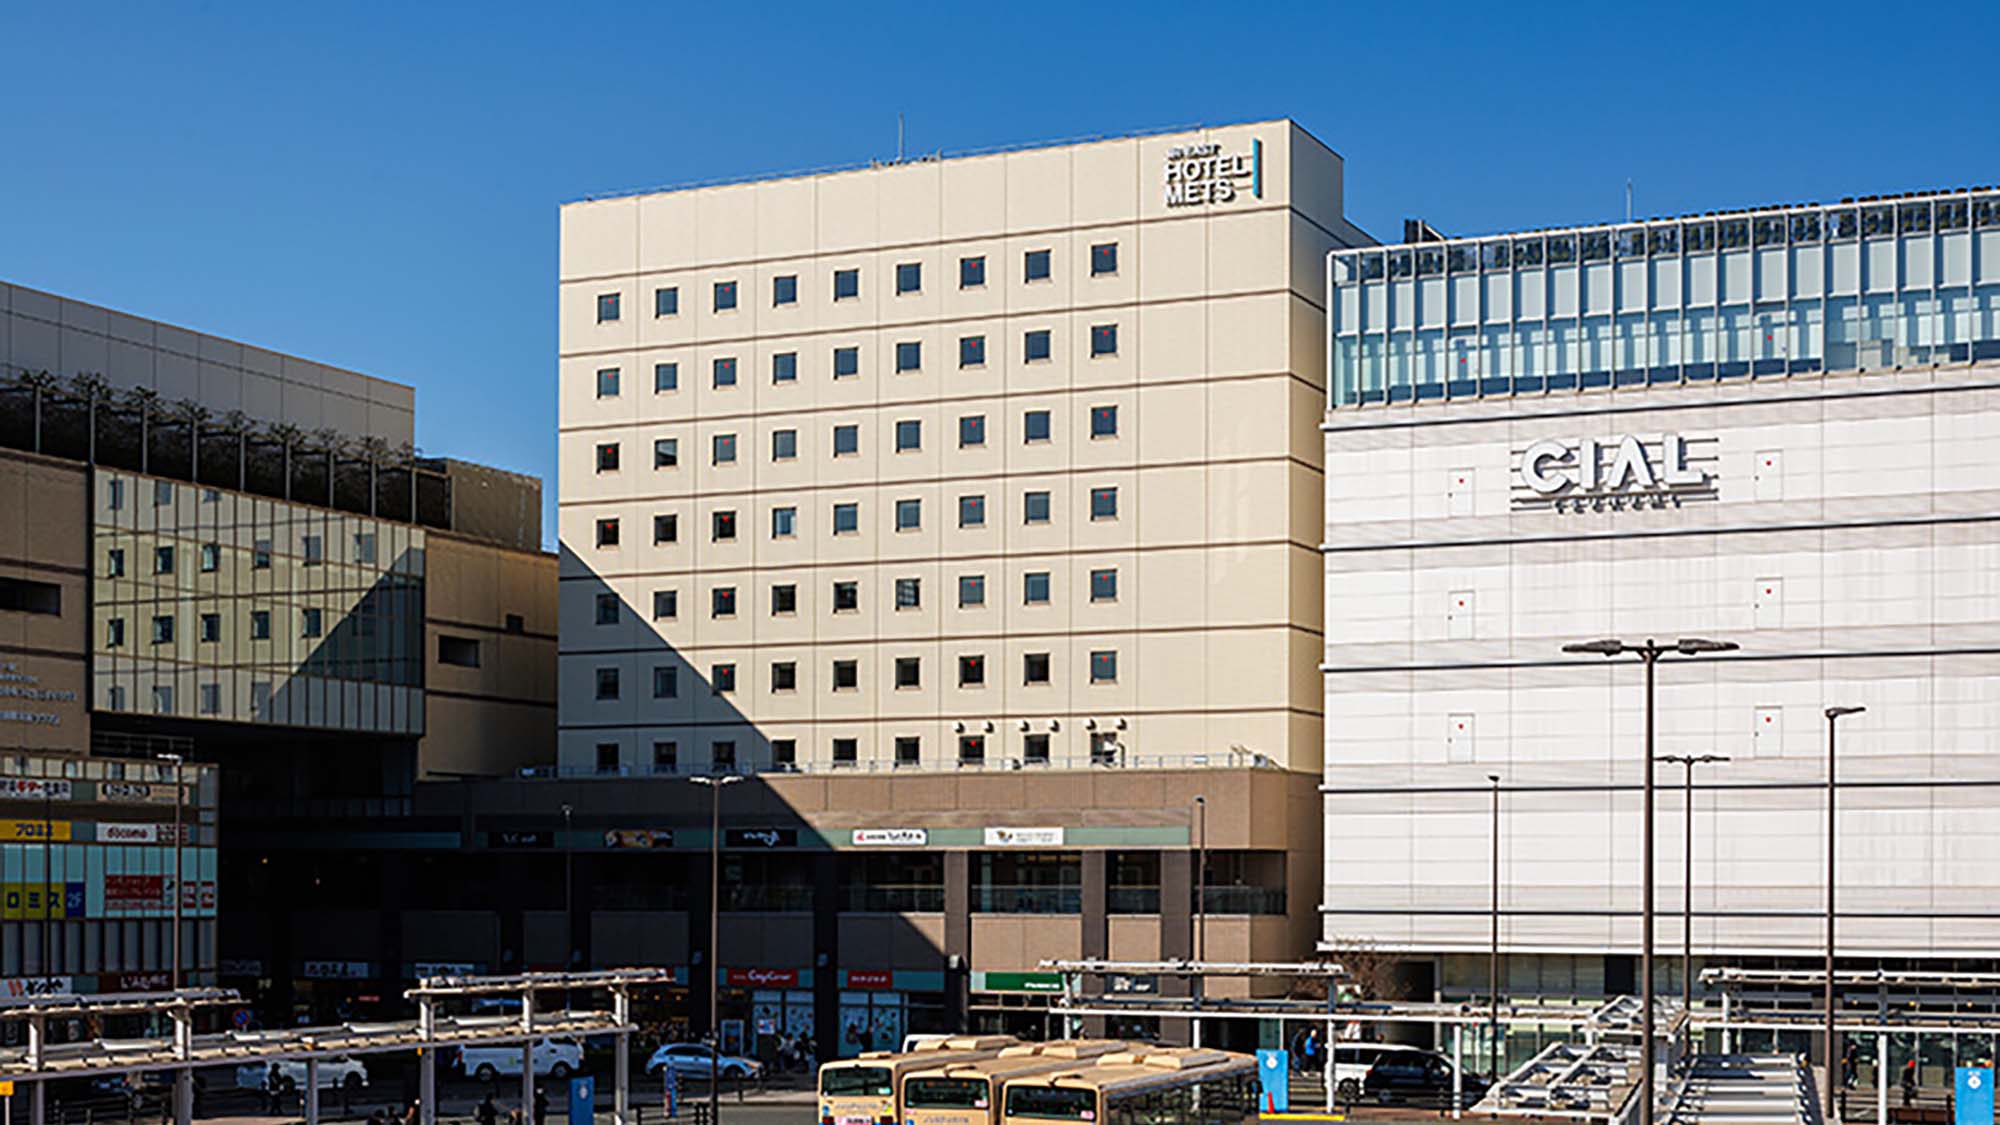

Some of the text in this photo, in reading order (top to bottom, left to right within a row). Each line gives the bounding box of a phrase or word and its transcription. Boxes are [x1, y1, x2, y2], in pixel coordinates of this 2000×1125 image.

[1164, 154, 1249, 182] HOTEL
[1165, 179, 1235, 207] METS
[1521, 434, 1706, 493] CIAL
[106, 826, 149, 841] docomo
